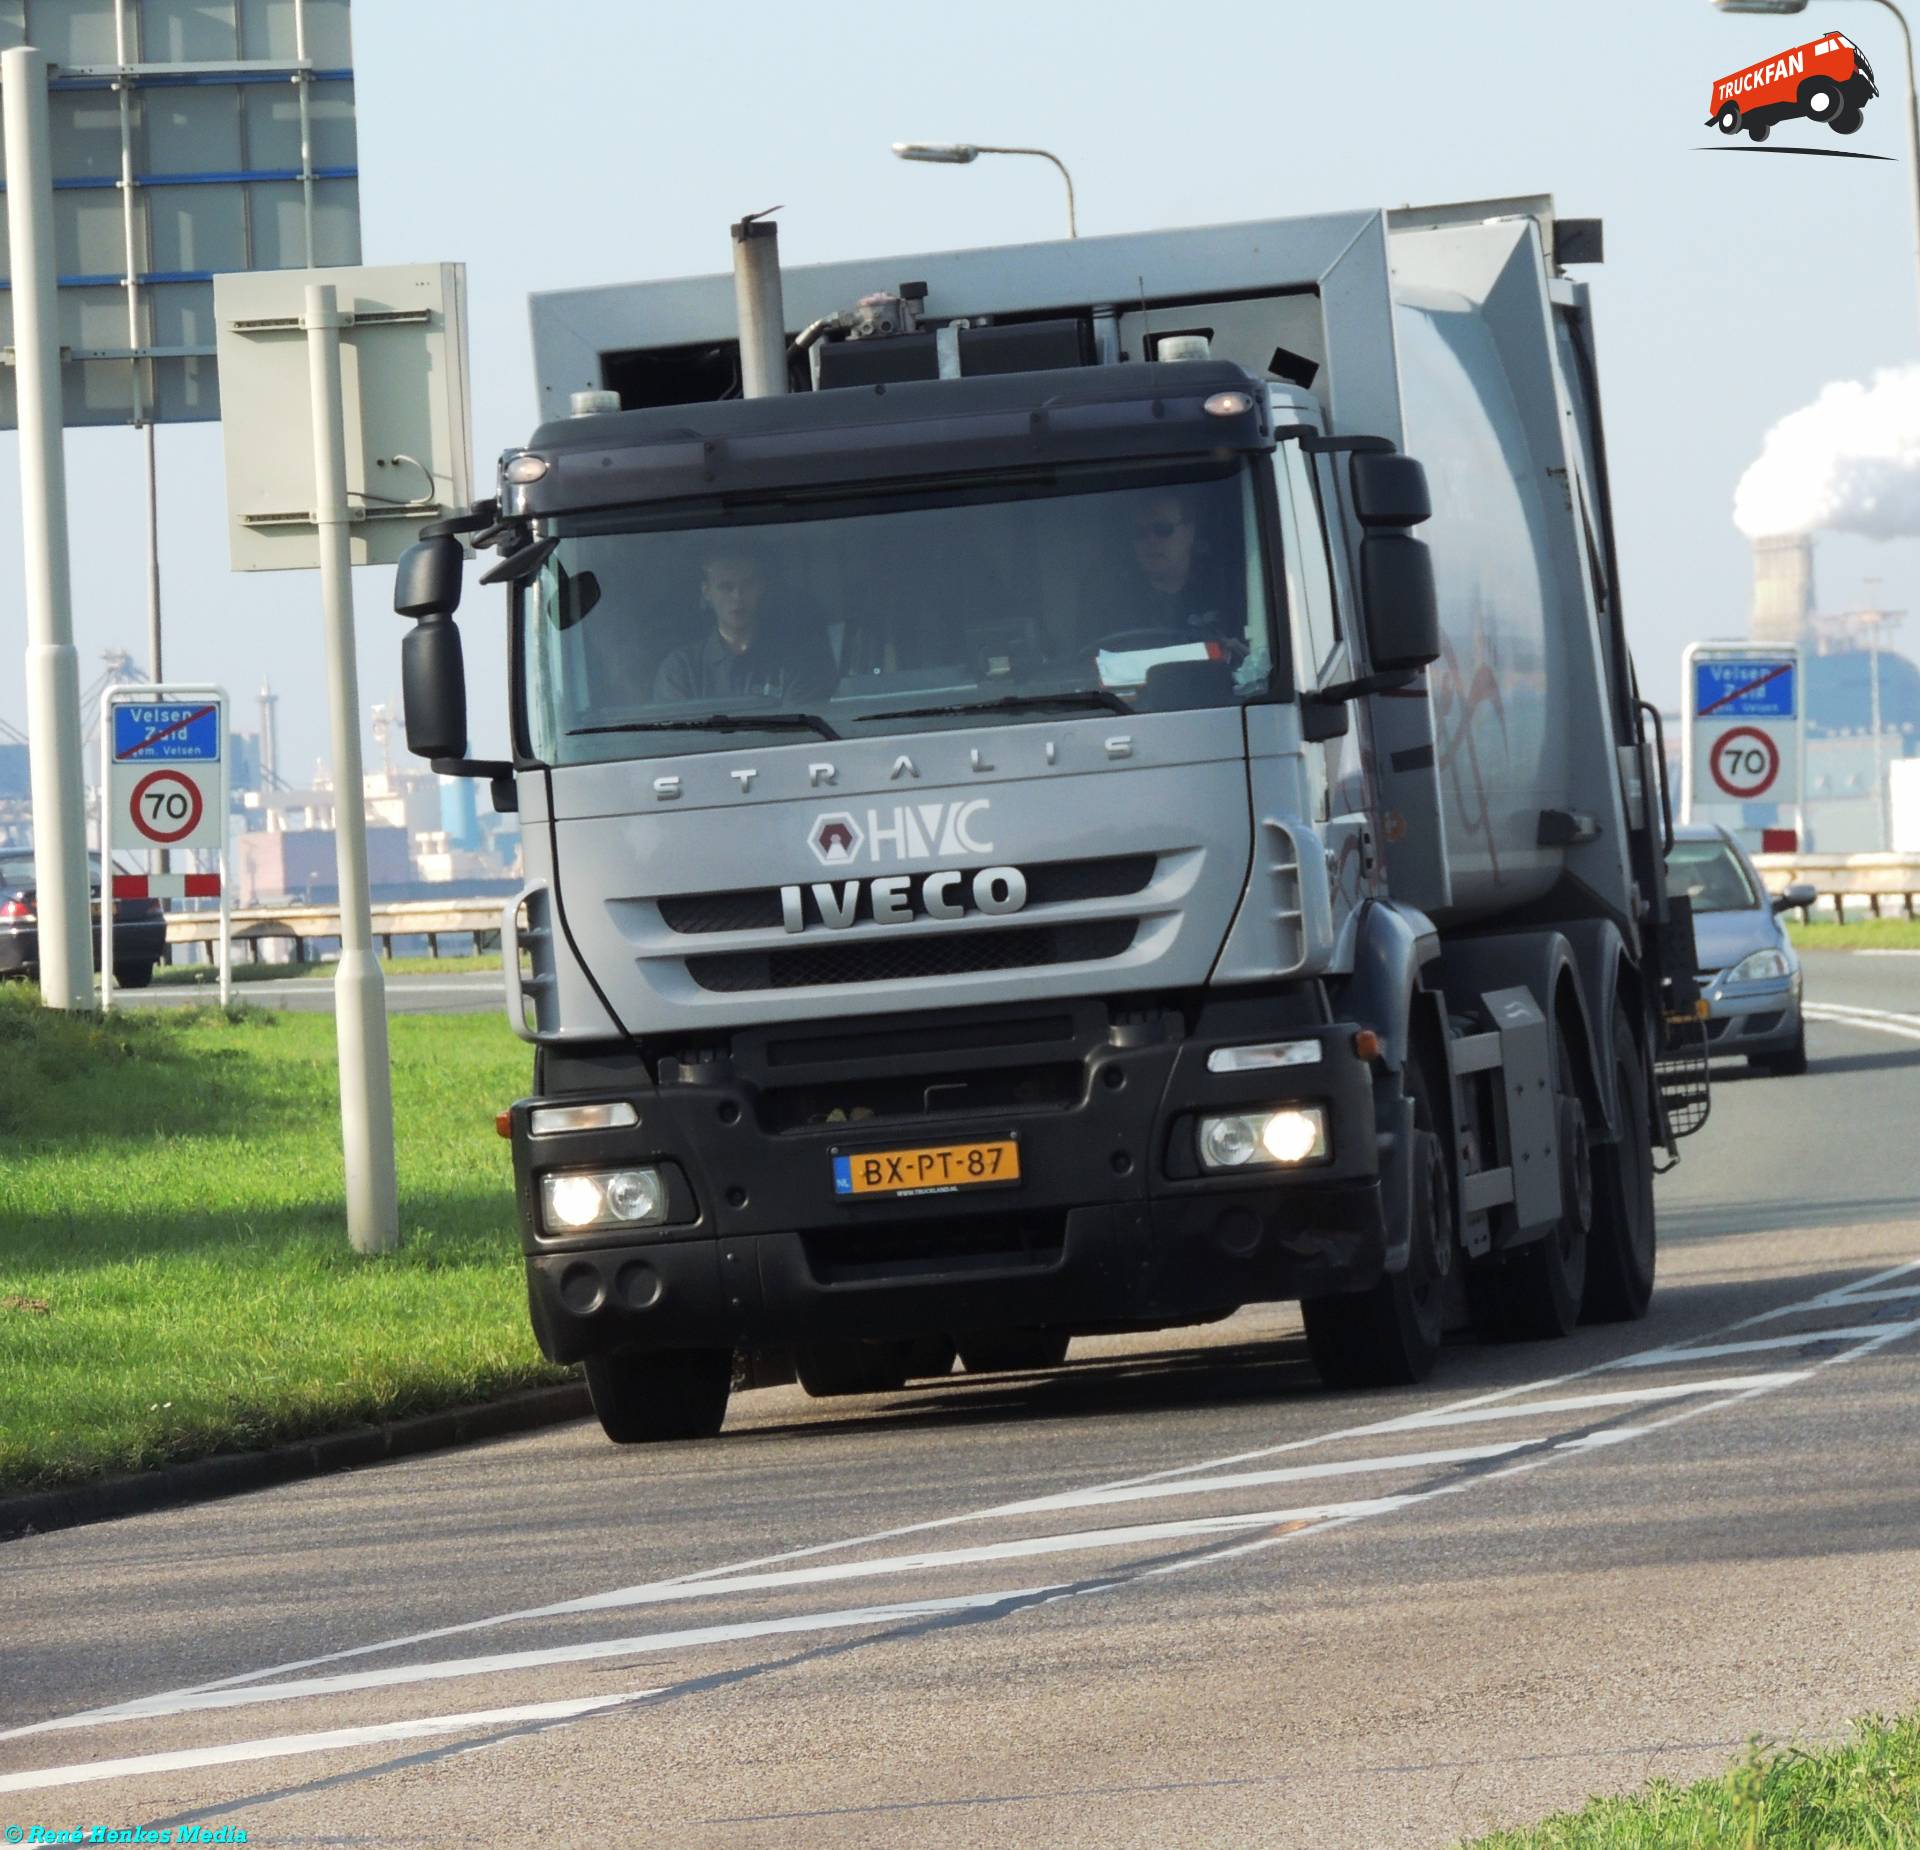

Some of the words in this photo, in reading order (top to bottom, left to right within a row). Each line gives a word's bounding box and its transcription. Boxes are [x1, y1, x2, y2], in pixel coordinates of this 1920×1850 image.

[1724, 683, 1767, 699] Zd
[130, 708, 192, 722] Velsen
[653, 735, 1134, 801] STRALIS
[1725, 750, 1766, 775] 70
[144, 793, 188, 820] 70
[867, 798, 995, 862] HVC
[780, 866, 1028, 934] IVECO
[864, 1147, 1004, 1186] BX-PT-87
[836, 1178, 850, 1188] NL
